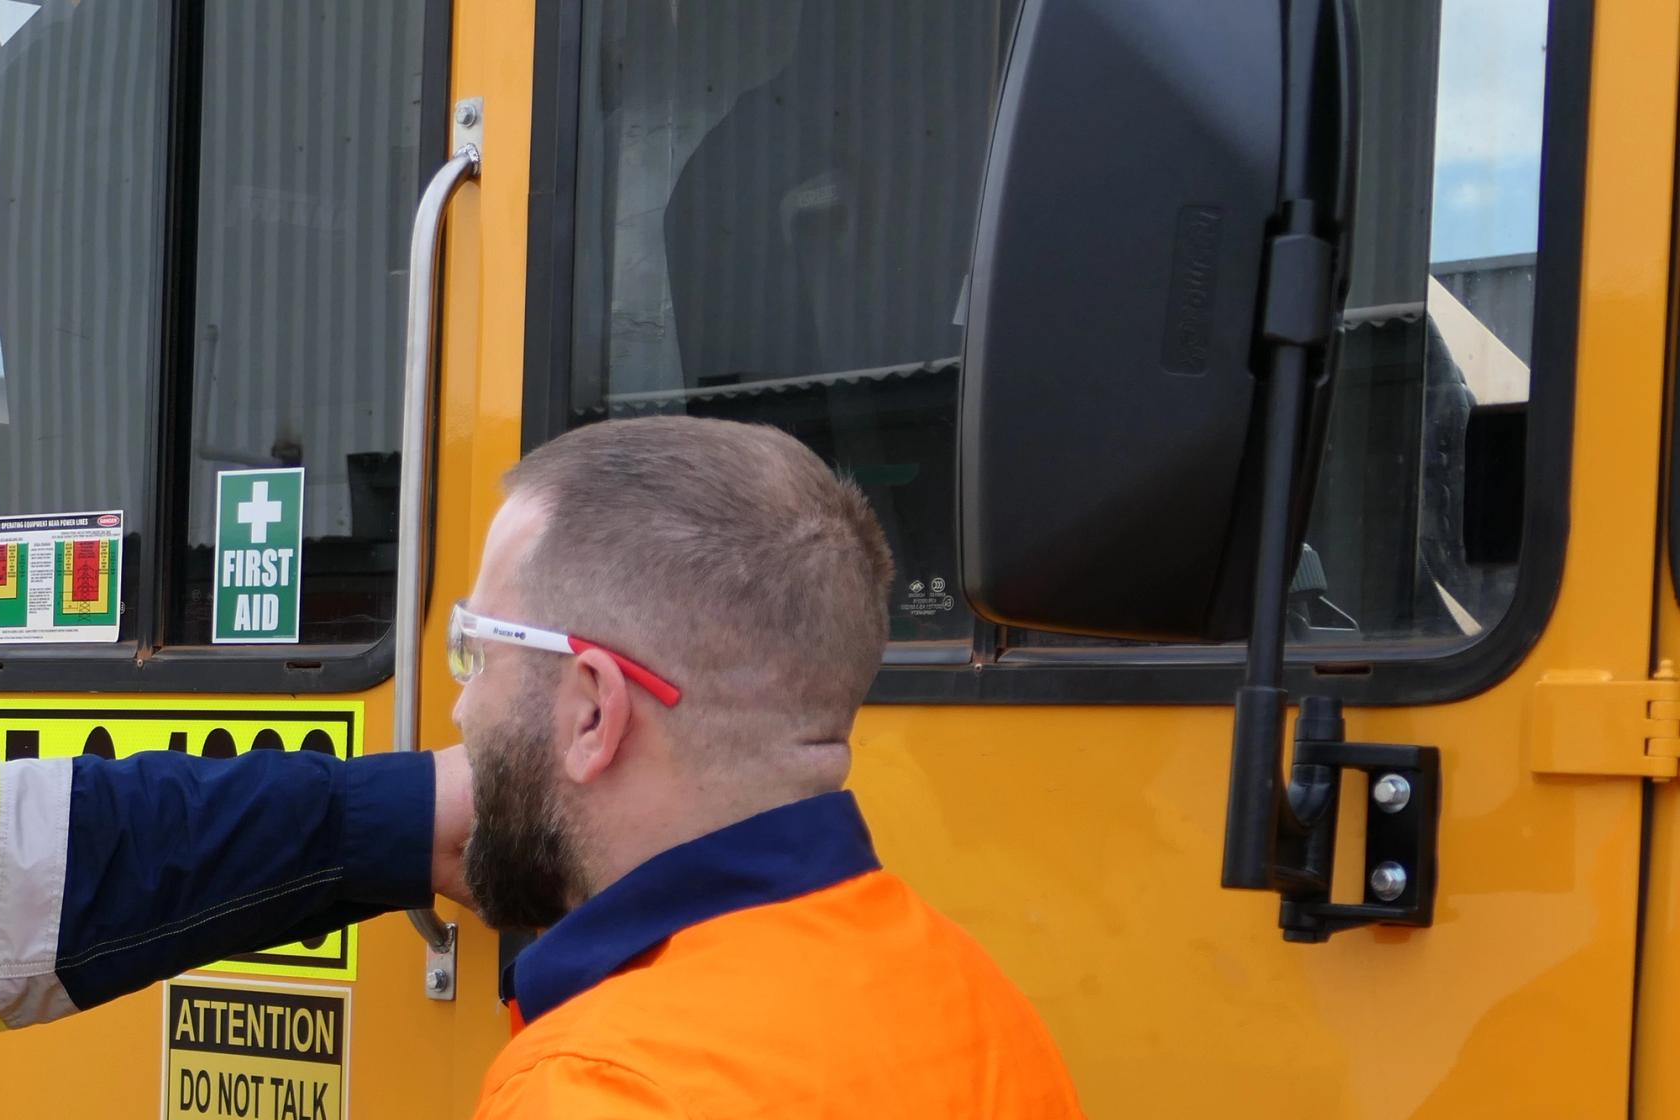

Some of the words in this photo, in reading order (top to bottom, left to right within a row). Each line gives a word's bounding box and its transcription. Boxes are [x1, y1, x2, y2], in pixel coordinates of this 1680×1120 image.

[1, 521, 23, 530] OPERATING
[24, 520, 47, 529] EQUIPMENT
[48, 519, 61, 527] NEAR
[60, 518, 75, 527] POWER
[76, 518, 88, 526] LINES
[222, 548, 294, 588] FIRST
[233, 593, 279, 631] AID
[175, 998, 335, 1055] ATTENTION
[180, 1068, 211, 1115] DO
[218, 1072, 264, 1120] NOT
